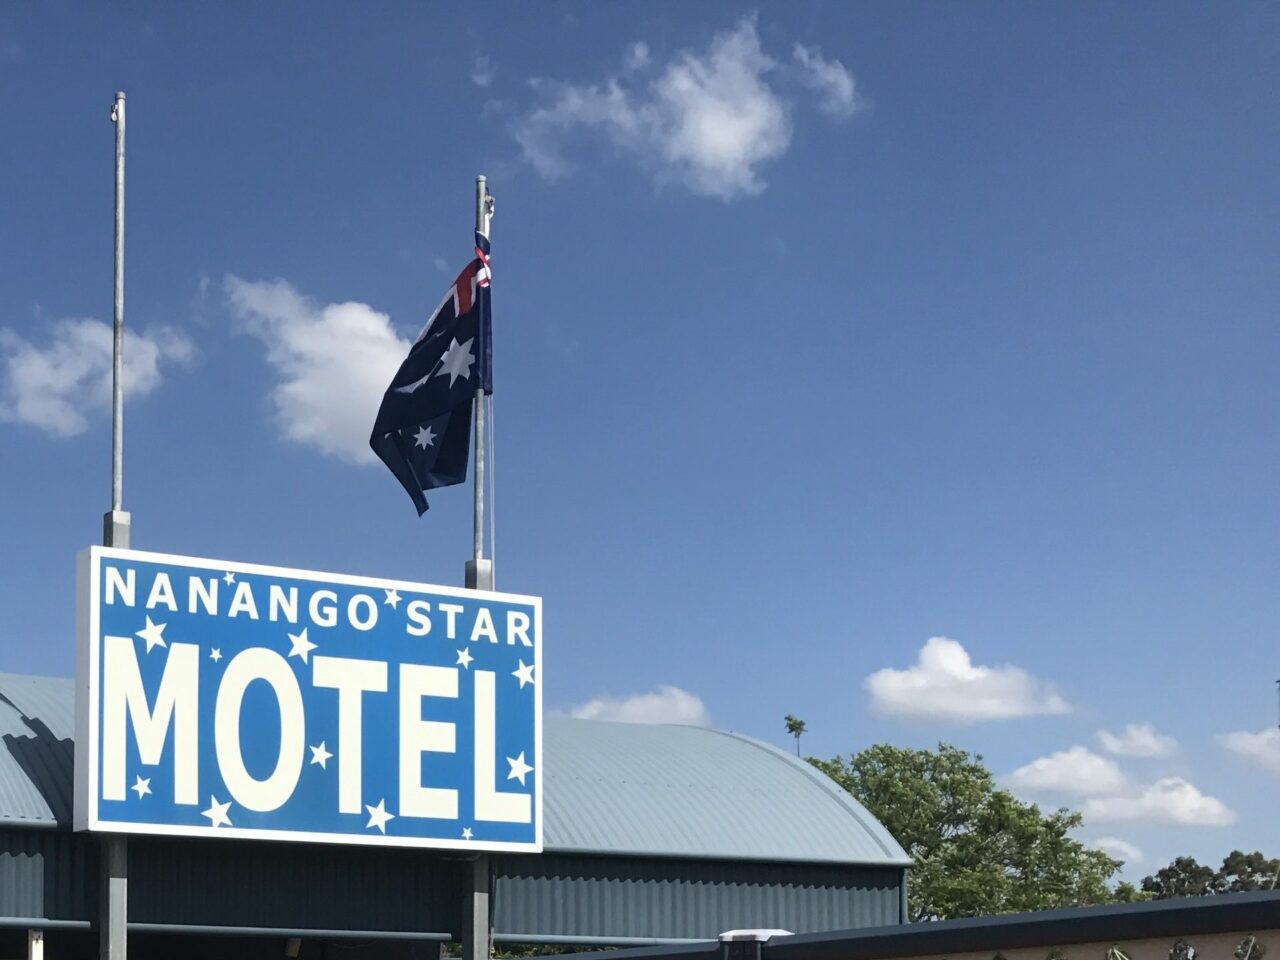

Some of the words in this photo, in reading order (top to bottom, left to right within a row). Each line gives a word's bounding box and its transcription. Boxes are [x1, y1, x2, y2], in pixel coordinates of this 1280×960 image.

[105, 567, 378, 631] NANANGO
[406, 600, 533, 647] STAR
[103, 635, 531, 823] MOTEL
